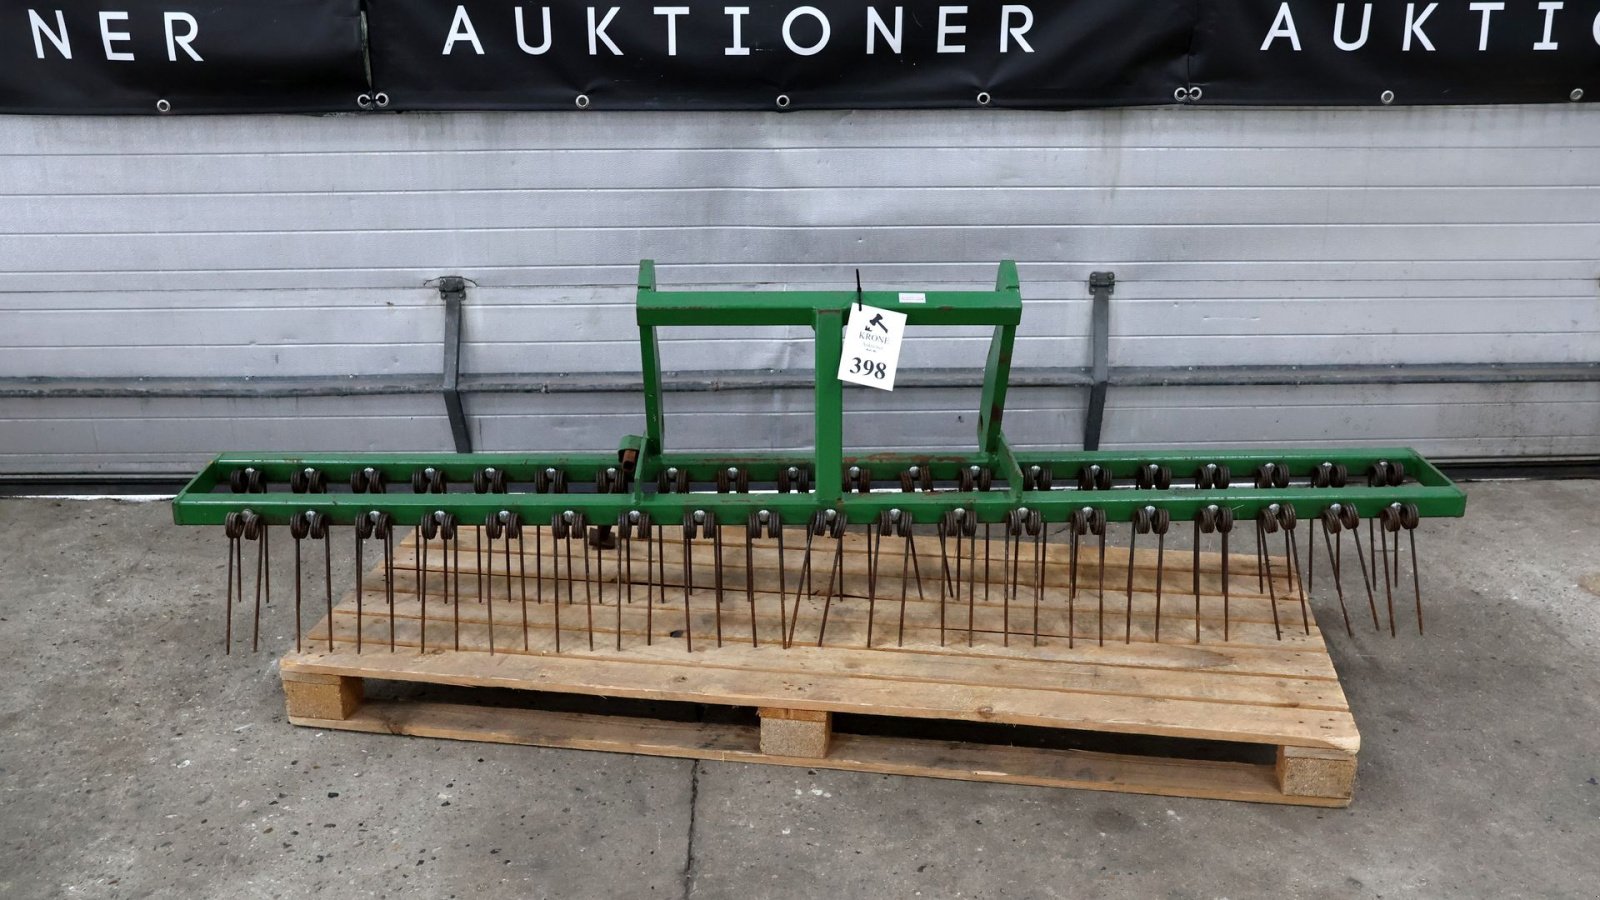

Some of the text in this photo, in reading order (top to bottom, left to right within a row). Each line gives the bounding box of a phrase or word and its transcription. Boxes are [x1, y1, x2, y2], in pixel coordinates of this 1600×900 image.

[442, 4, 1035, 56] AUKTIONER
[1260, 1, 1600, 52] AUKTI
[849, 356, 887, 380] 398
